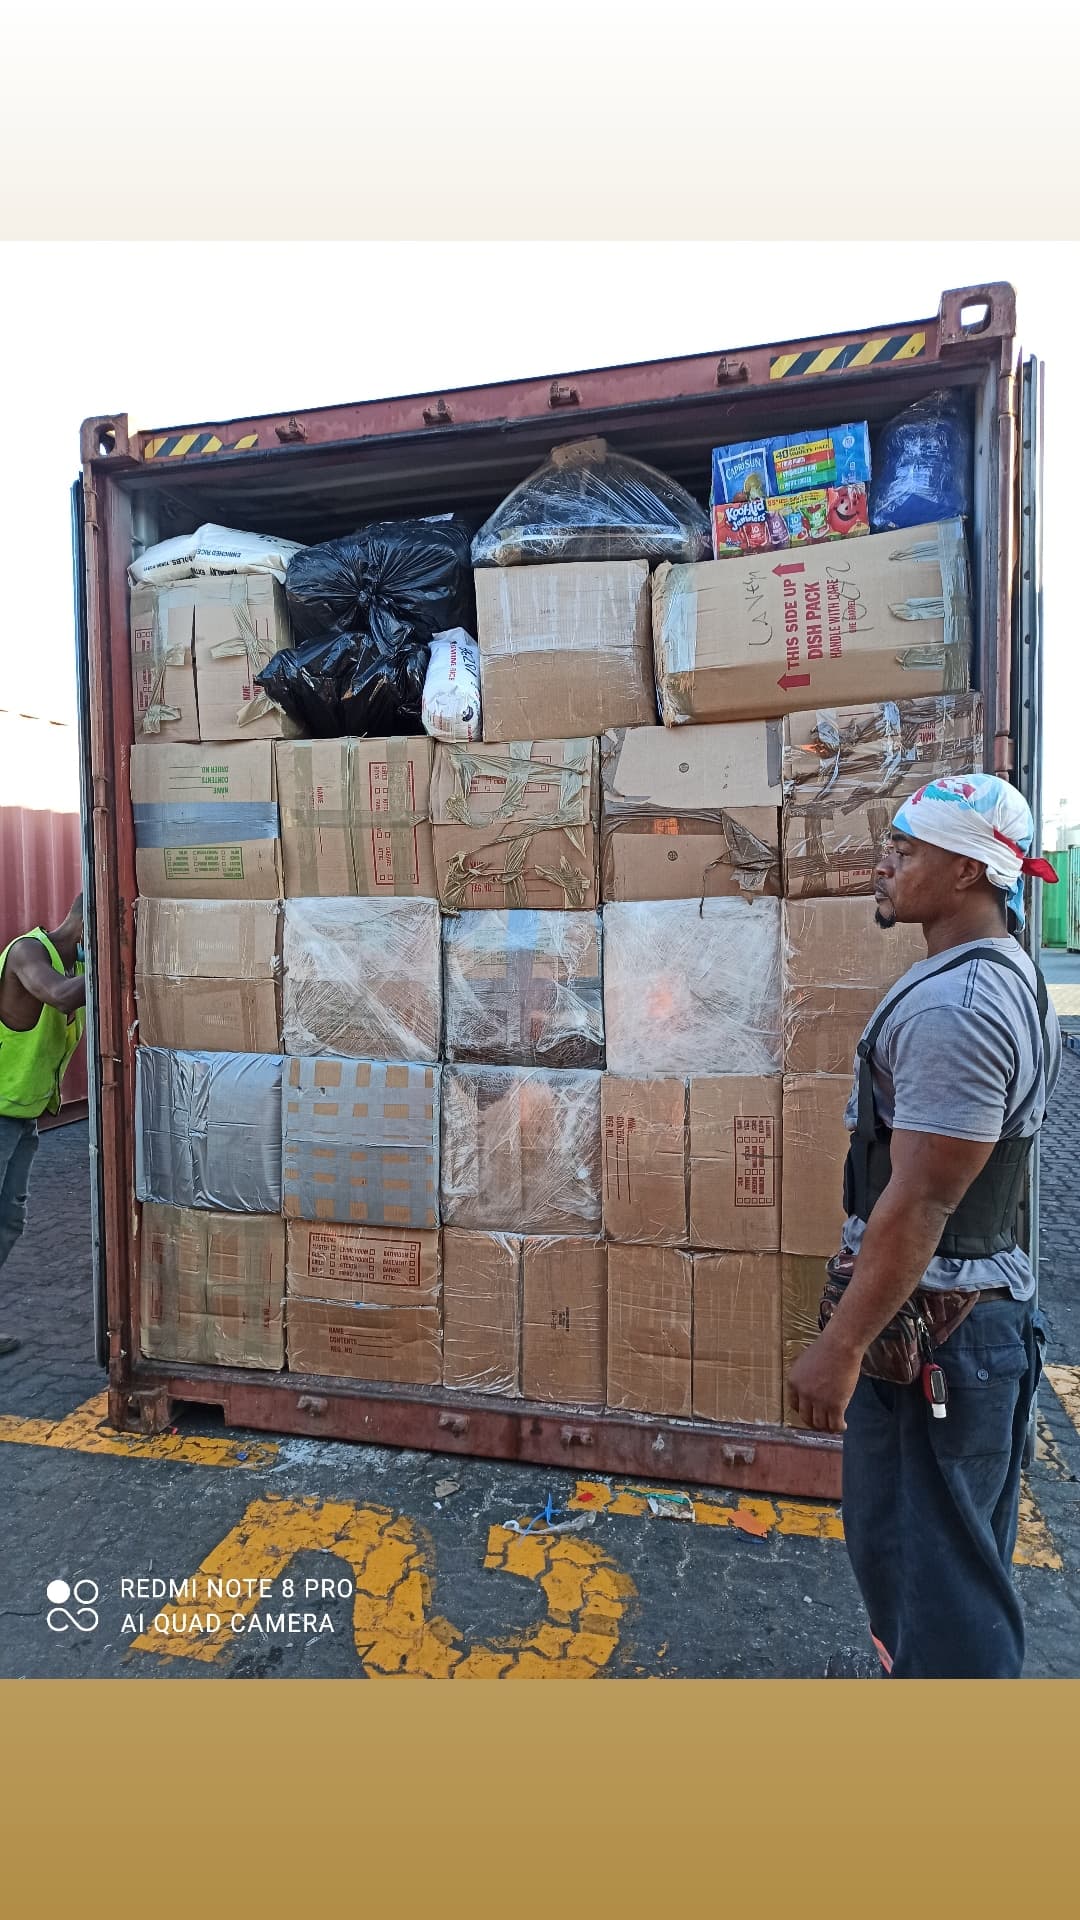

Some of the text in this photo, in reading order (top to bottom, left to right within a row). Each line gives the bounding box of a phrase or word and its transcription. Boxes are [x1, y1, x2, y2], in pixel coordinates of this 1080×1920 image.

[776, 449, 789, 460] 40
[725, 456, 762, 480] CAPRI SUN
[725, 499, 765, 522] Kool-Aid
[731, 512, 766, 531] Jammers
[772, 520, 780, 528] 10
[791, 516, 798, 524] 10
[783, 578, 801, 671] THIS SIDE UP
[804, 580, 824, 660] DISH PACK
[826, 578, 843, 659] HANDLE WITH CARE
[201, 776, 229, 784] CONTENTS
[316, 786, 324, 804] NAME
[616, 1116, 625, 1145] CONTENTS
[328, 1327, 345, 1335] NAME
[329, 1336, 358, 1345] CONTENTS
